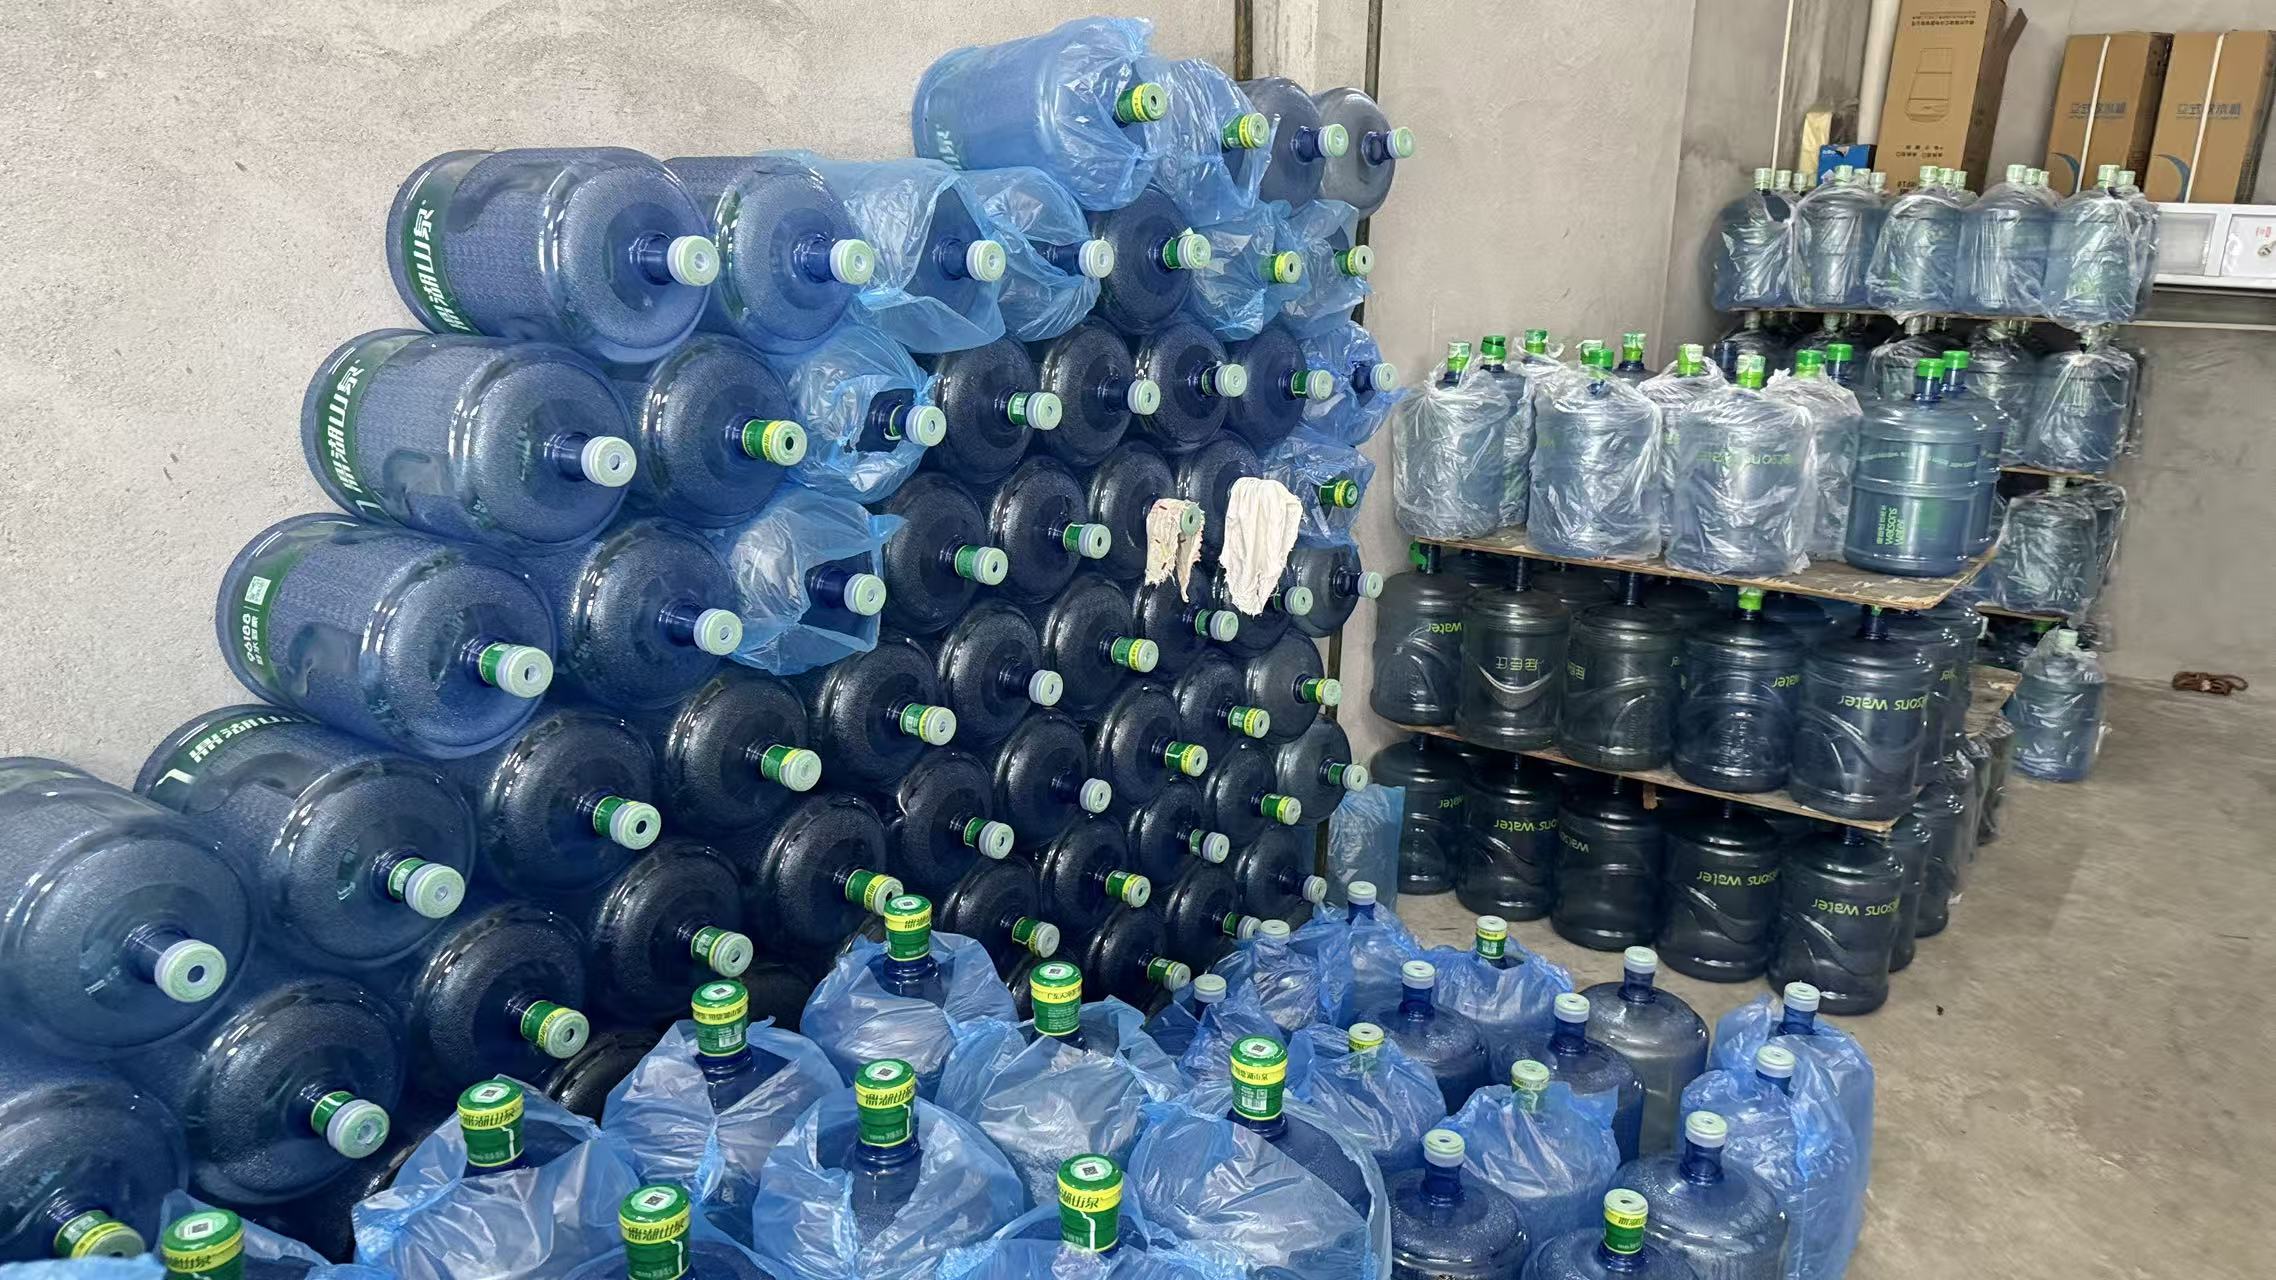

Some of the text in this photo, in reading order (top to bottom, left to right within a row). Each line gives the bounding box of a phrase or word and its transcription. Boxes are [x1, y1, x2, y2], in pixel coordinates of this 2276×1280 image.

[327, 363, 364, 493] 鼎湖山泉
[1837, 694, 1888, 712] water
[188, 714, 292, 763] 鼎湖山
[1494, 819, 1535, 833] water
[1696, 871, 1743, 887] water
[1811, 898, 1860, 917] water
[628, 1217, 684, 1241] 鼎湖山泉
